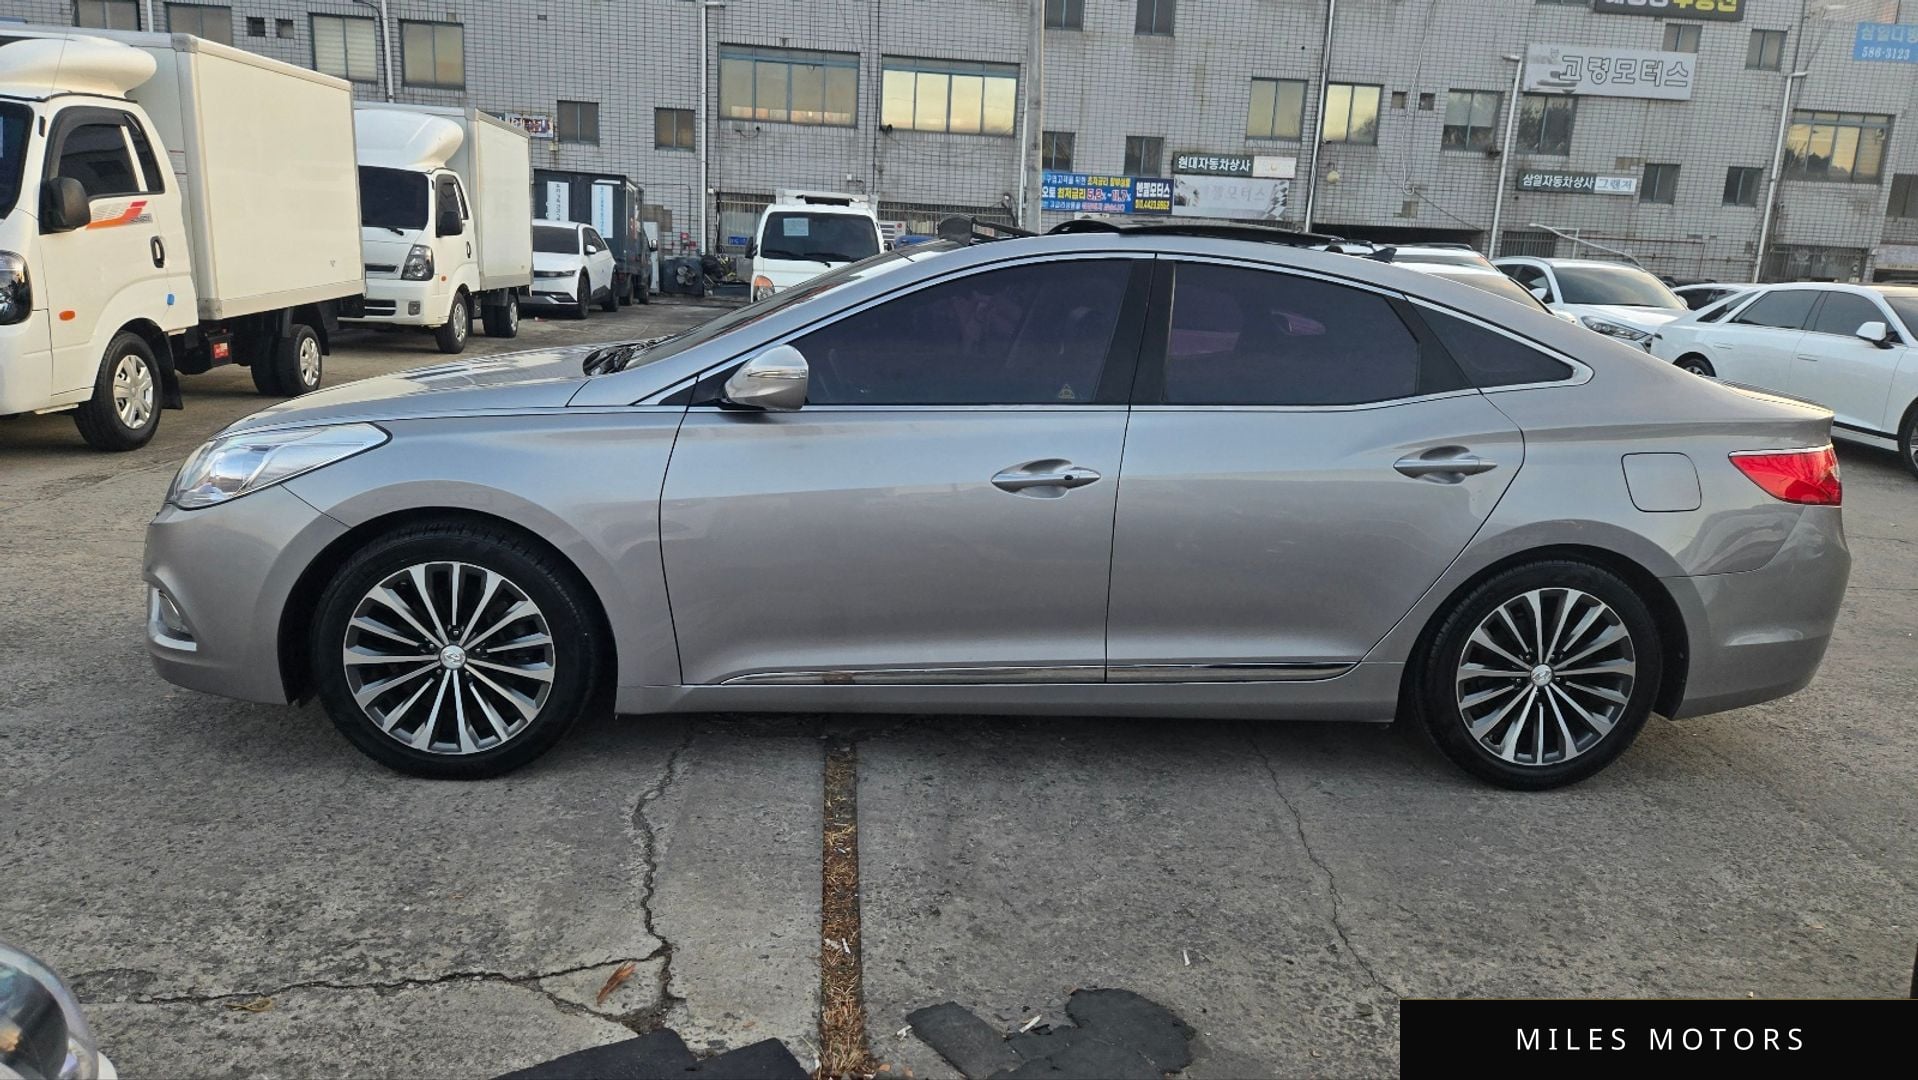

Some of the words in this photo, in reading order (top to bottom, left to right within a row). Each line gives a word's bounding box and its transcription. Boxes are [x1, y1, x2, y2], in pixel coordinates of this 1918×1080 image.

[1559, 55, 1689, 88] 고령모터스
[1178, 155, 1250, 172] 현대자동차상사
[1523, 173, 1594, 190] 삼일자동차상사
